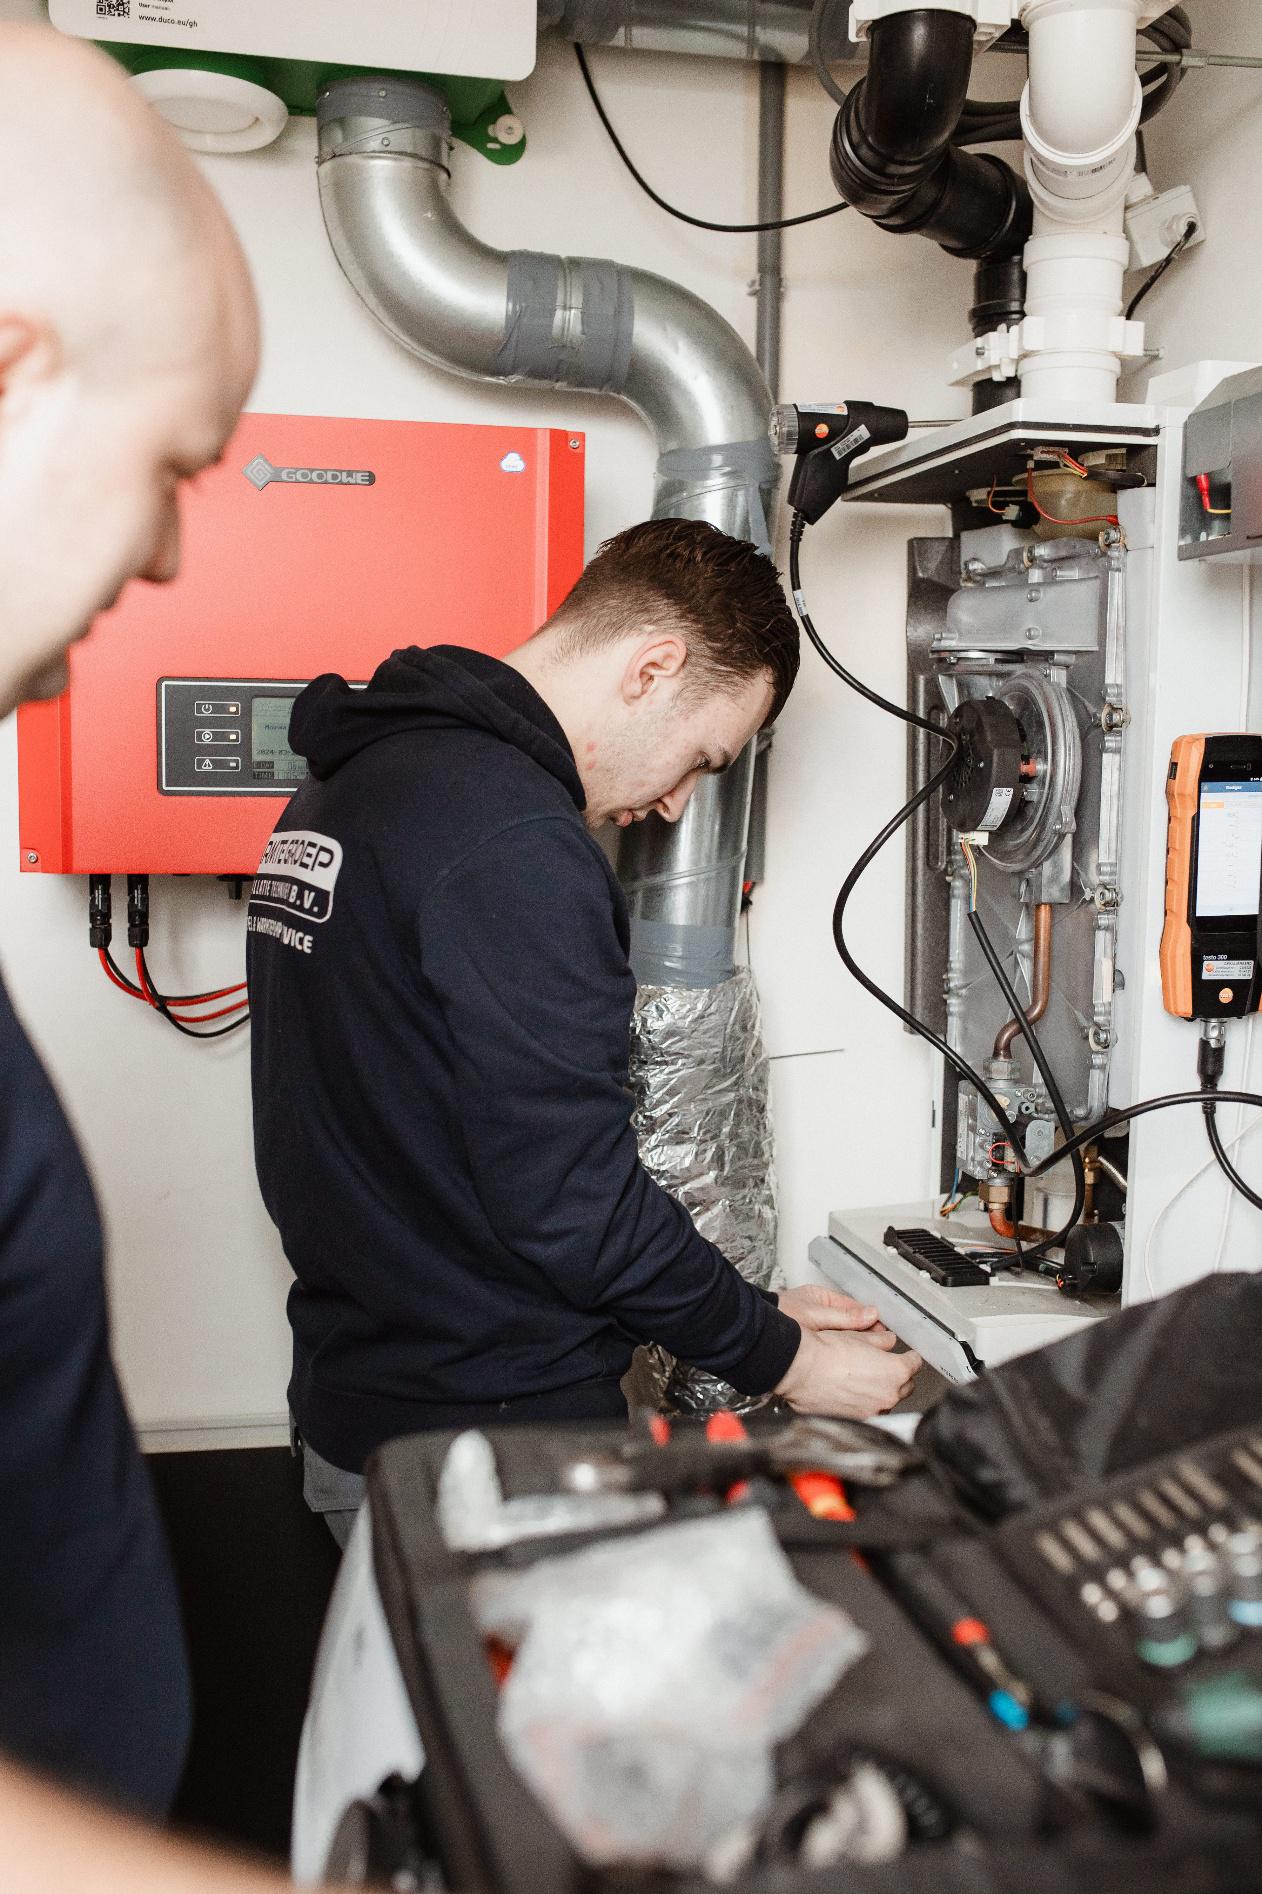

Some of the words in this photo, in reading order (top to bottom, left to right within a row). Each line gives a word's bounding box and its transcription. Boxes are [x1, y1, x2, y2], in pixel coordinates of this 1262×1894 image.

[138, 14, 198, 28] www.duco.eu/gh
[281, 468, 370, 485] GOODWE
[288, 885, 319, 913] B.V.
